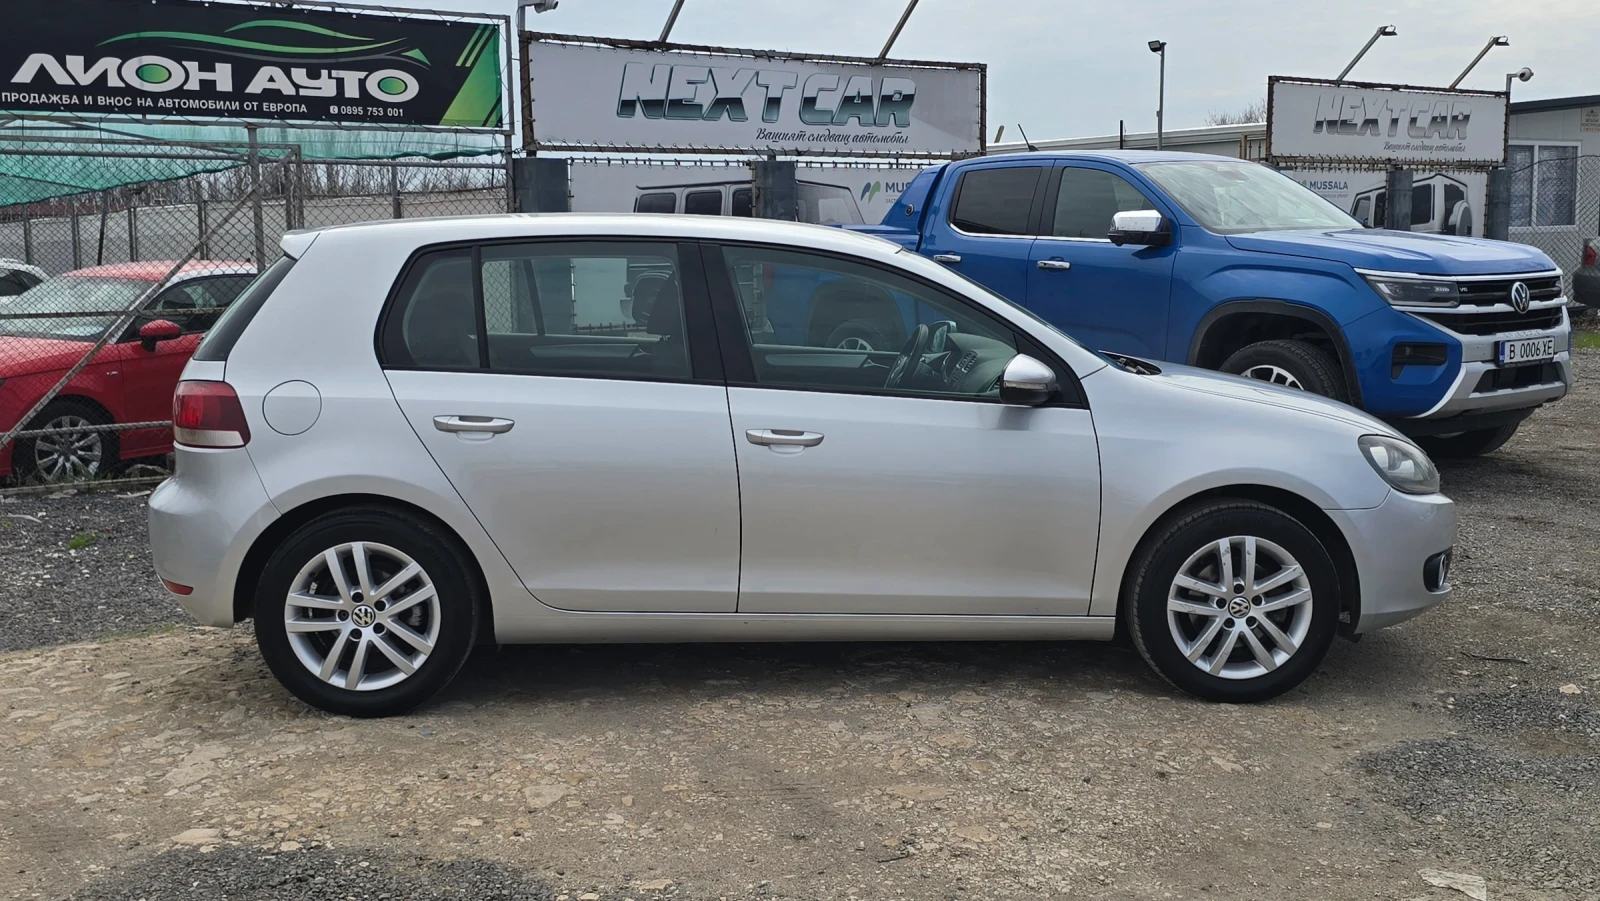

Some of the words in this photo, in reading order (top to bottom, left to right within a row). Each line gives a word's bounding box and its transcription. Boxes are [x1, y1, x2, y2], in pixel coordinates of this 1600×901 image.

[10, 52, 233, 93] ЛИОН
[244, 66, 420, 103] АУТО
[1, 92, 80, 105] ПРОДАЖБА
[84, 95, 93, 105] И
[97, 95, 132, 107] ВНОС
[137, 97, 154, 107] НА
[158, 97, 240, 111] АВТОМОБИЛИ
[244, 101, 259, 111] ОТ
[263, 102, 308, 113] ЕВРОПА
[616, 61, 917, 129] NEXTCAR
[340, 105, 364, 115] 0895
[367, 107, 384, 116] 753
[387, 107, 404, 117] 001
[756, 127, 807, 143] Вашият
[807, 128, 852, 146] следващ
[852, 131, 909, 144] автомобил
[1309, 180, 1349, 190] MUSSALA
[1509, 343, 1516, 360] B
[1520, 340, 1541, 359] 0006
[1541, 339, 1553, 357] XE
